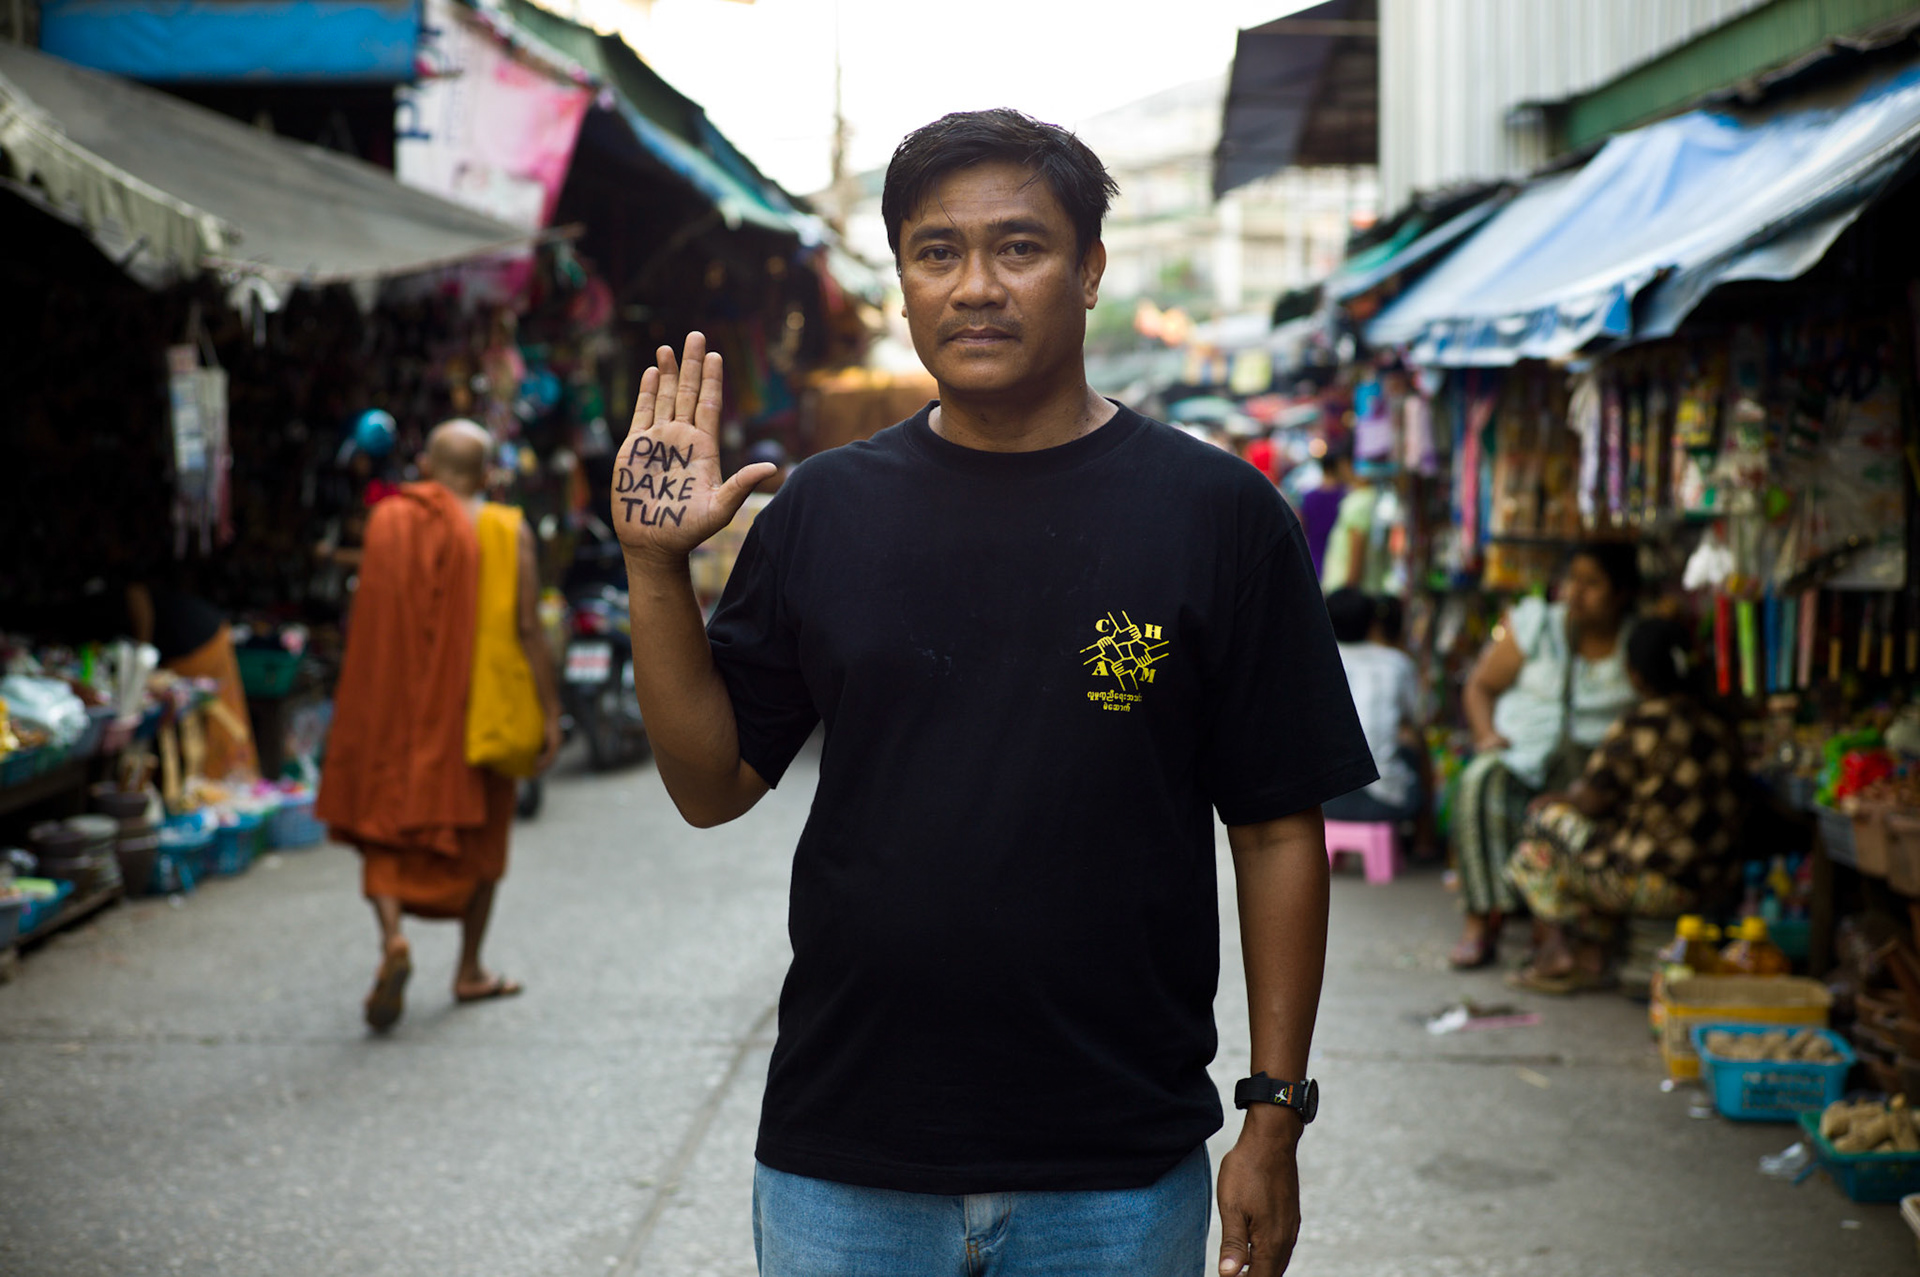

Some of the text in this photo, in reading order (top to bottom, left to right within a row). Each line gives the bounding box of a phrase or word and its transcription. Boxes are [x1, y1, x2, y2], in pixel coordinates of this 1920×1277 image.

[627, 436, 694, 472] PAN
[615, 467, 696, 502] DAKE
[620, 497, 687, 528] TUN
